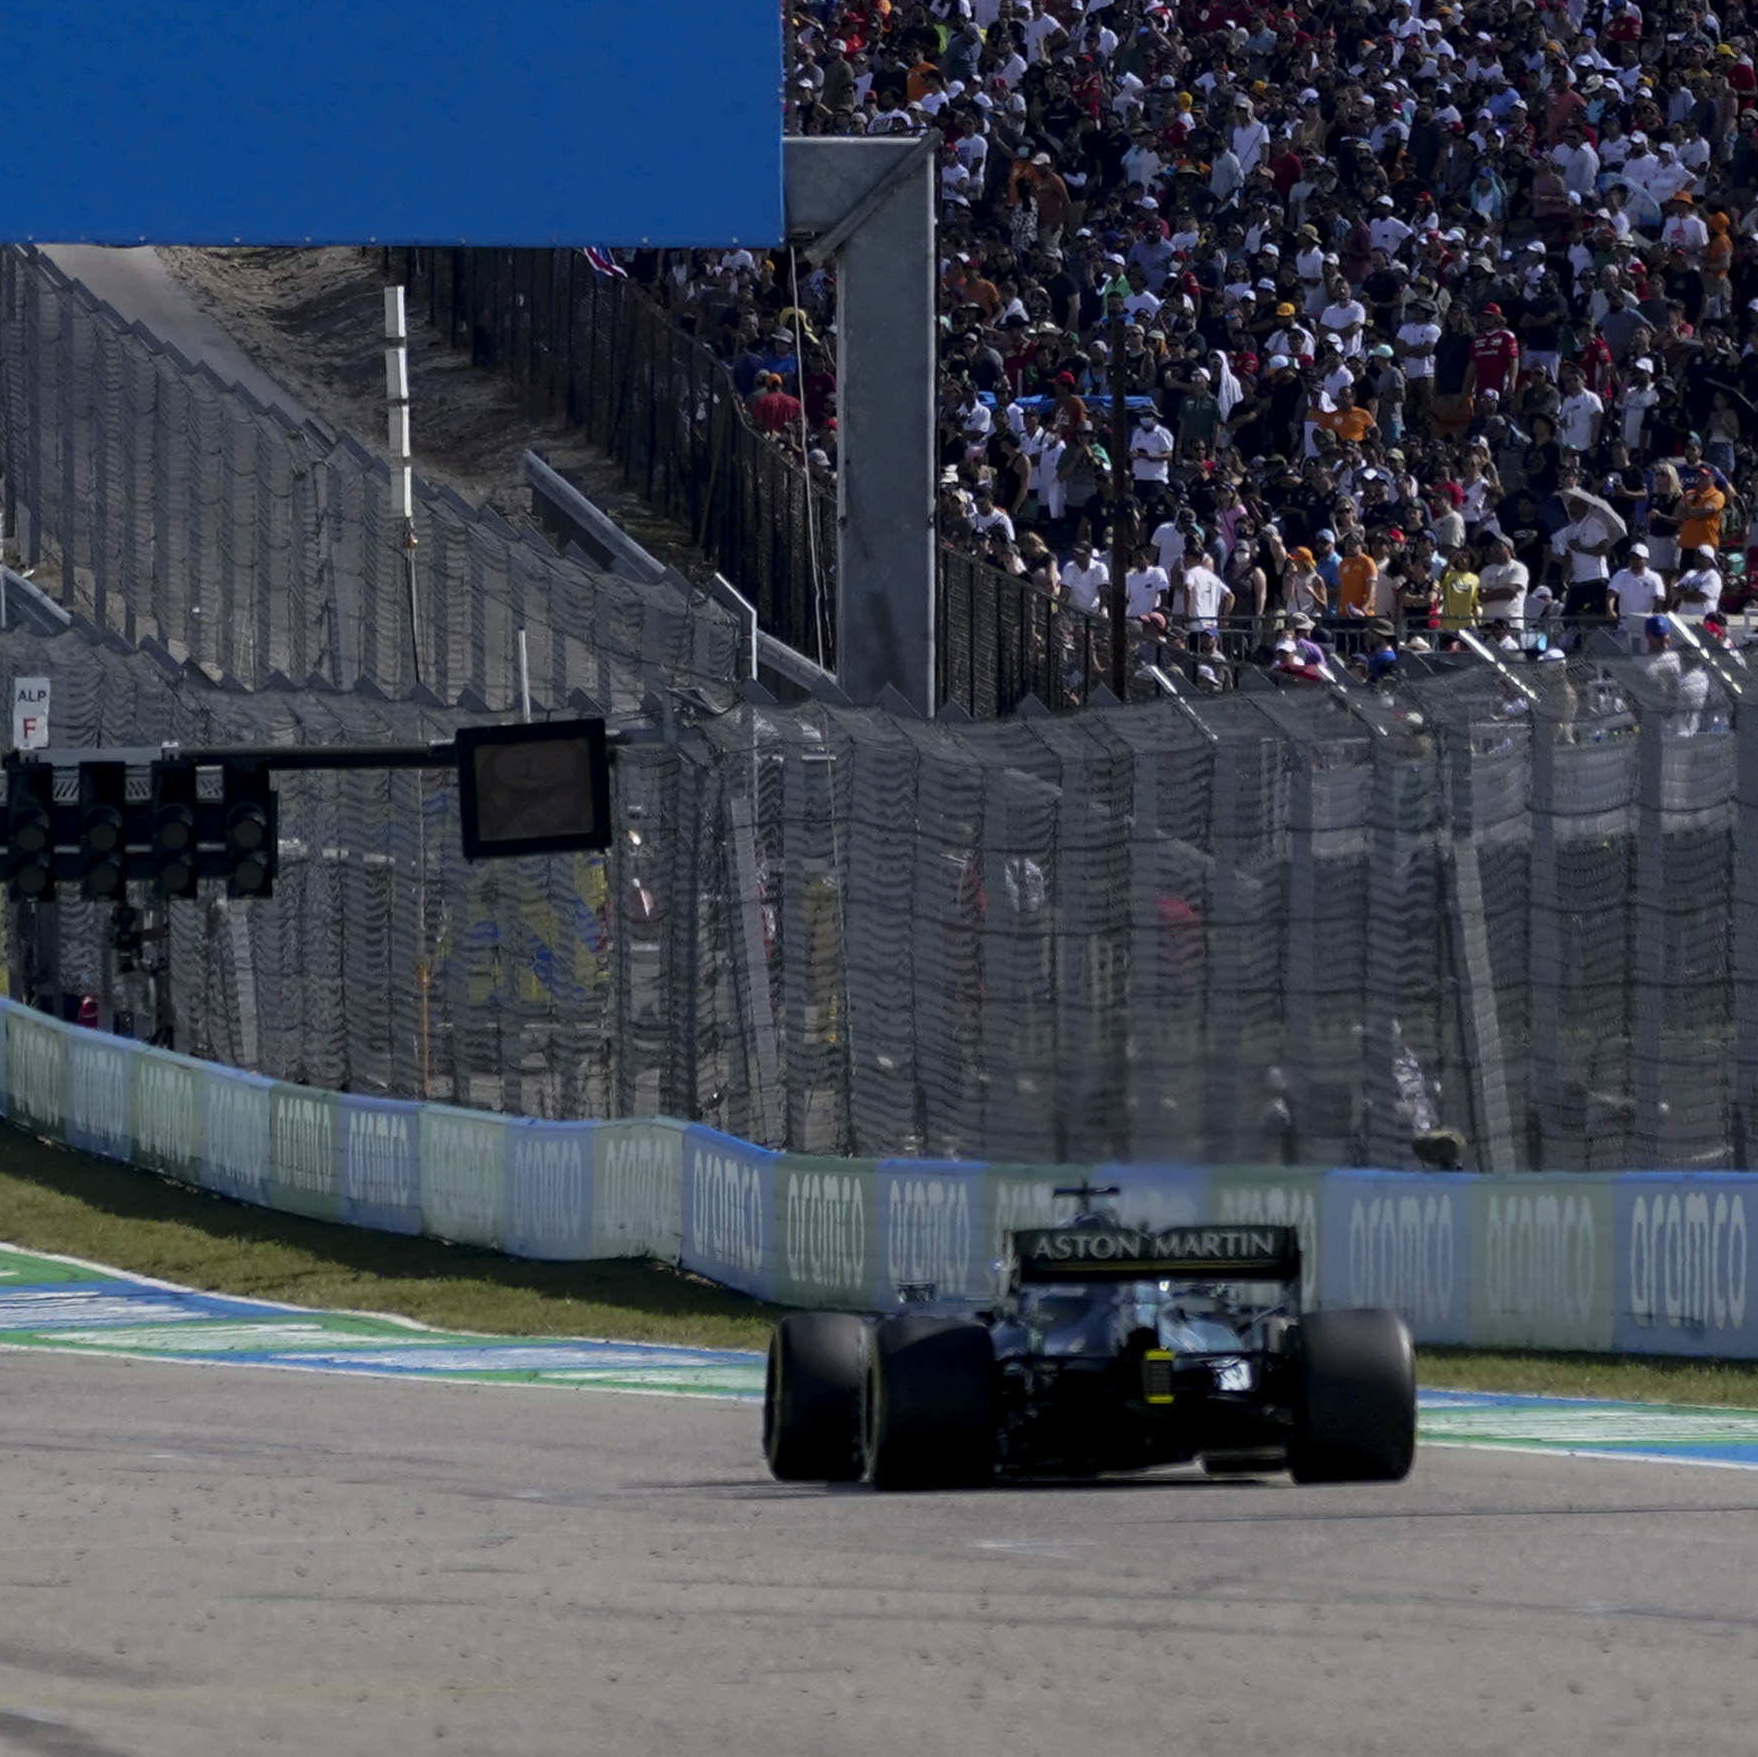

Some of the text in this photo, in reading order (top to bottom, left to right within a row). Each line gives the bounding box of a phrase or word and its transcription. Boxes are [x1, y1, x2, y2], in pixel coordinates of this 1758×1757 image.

[17, 689, 47, 702] ALP
[23, 717, 37, 739] F
[1033, 1232, 1275, 1260] ASTON MARTIN
[1630, 1191, 1748, 1331] aramco
